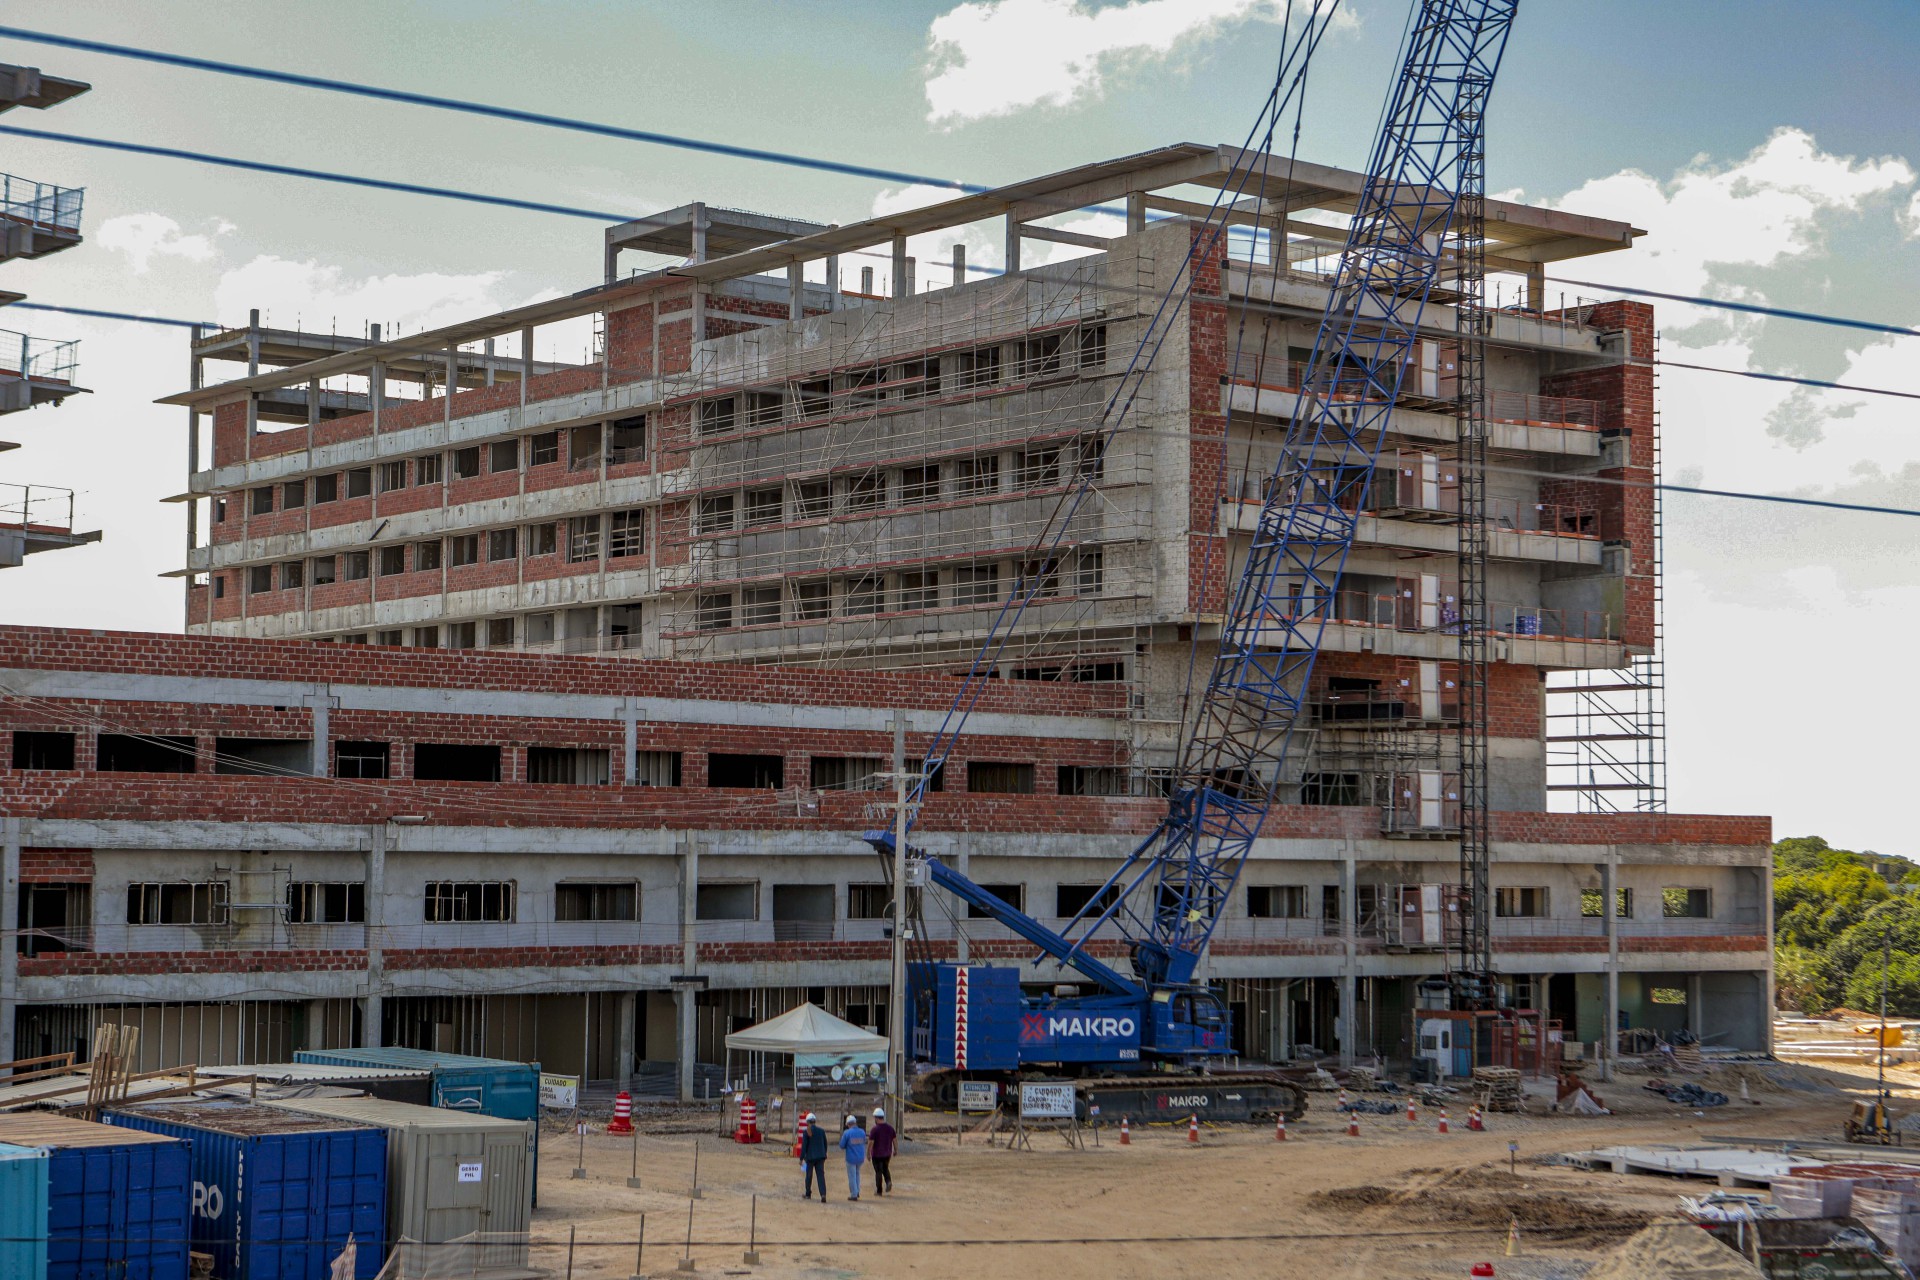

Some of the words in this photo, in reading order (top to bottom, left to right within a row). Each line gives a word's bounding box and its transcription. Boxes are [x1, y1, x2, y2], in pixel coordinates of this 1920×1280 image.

[1049, 1017, 1135, 1037] MAKRO
[544, 1078, 567, 1087] CUIDADO
[1034, 1087, 1062, 1096] CUIDADO
[1168, 1095, 1208, 1108] MAKRO
